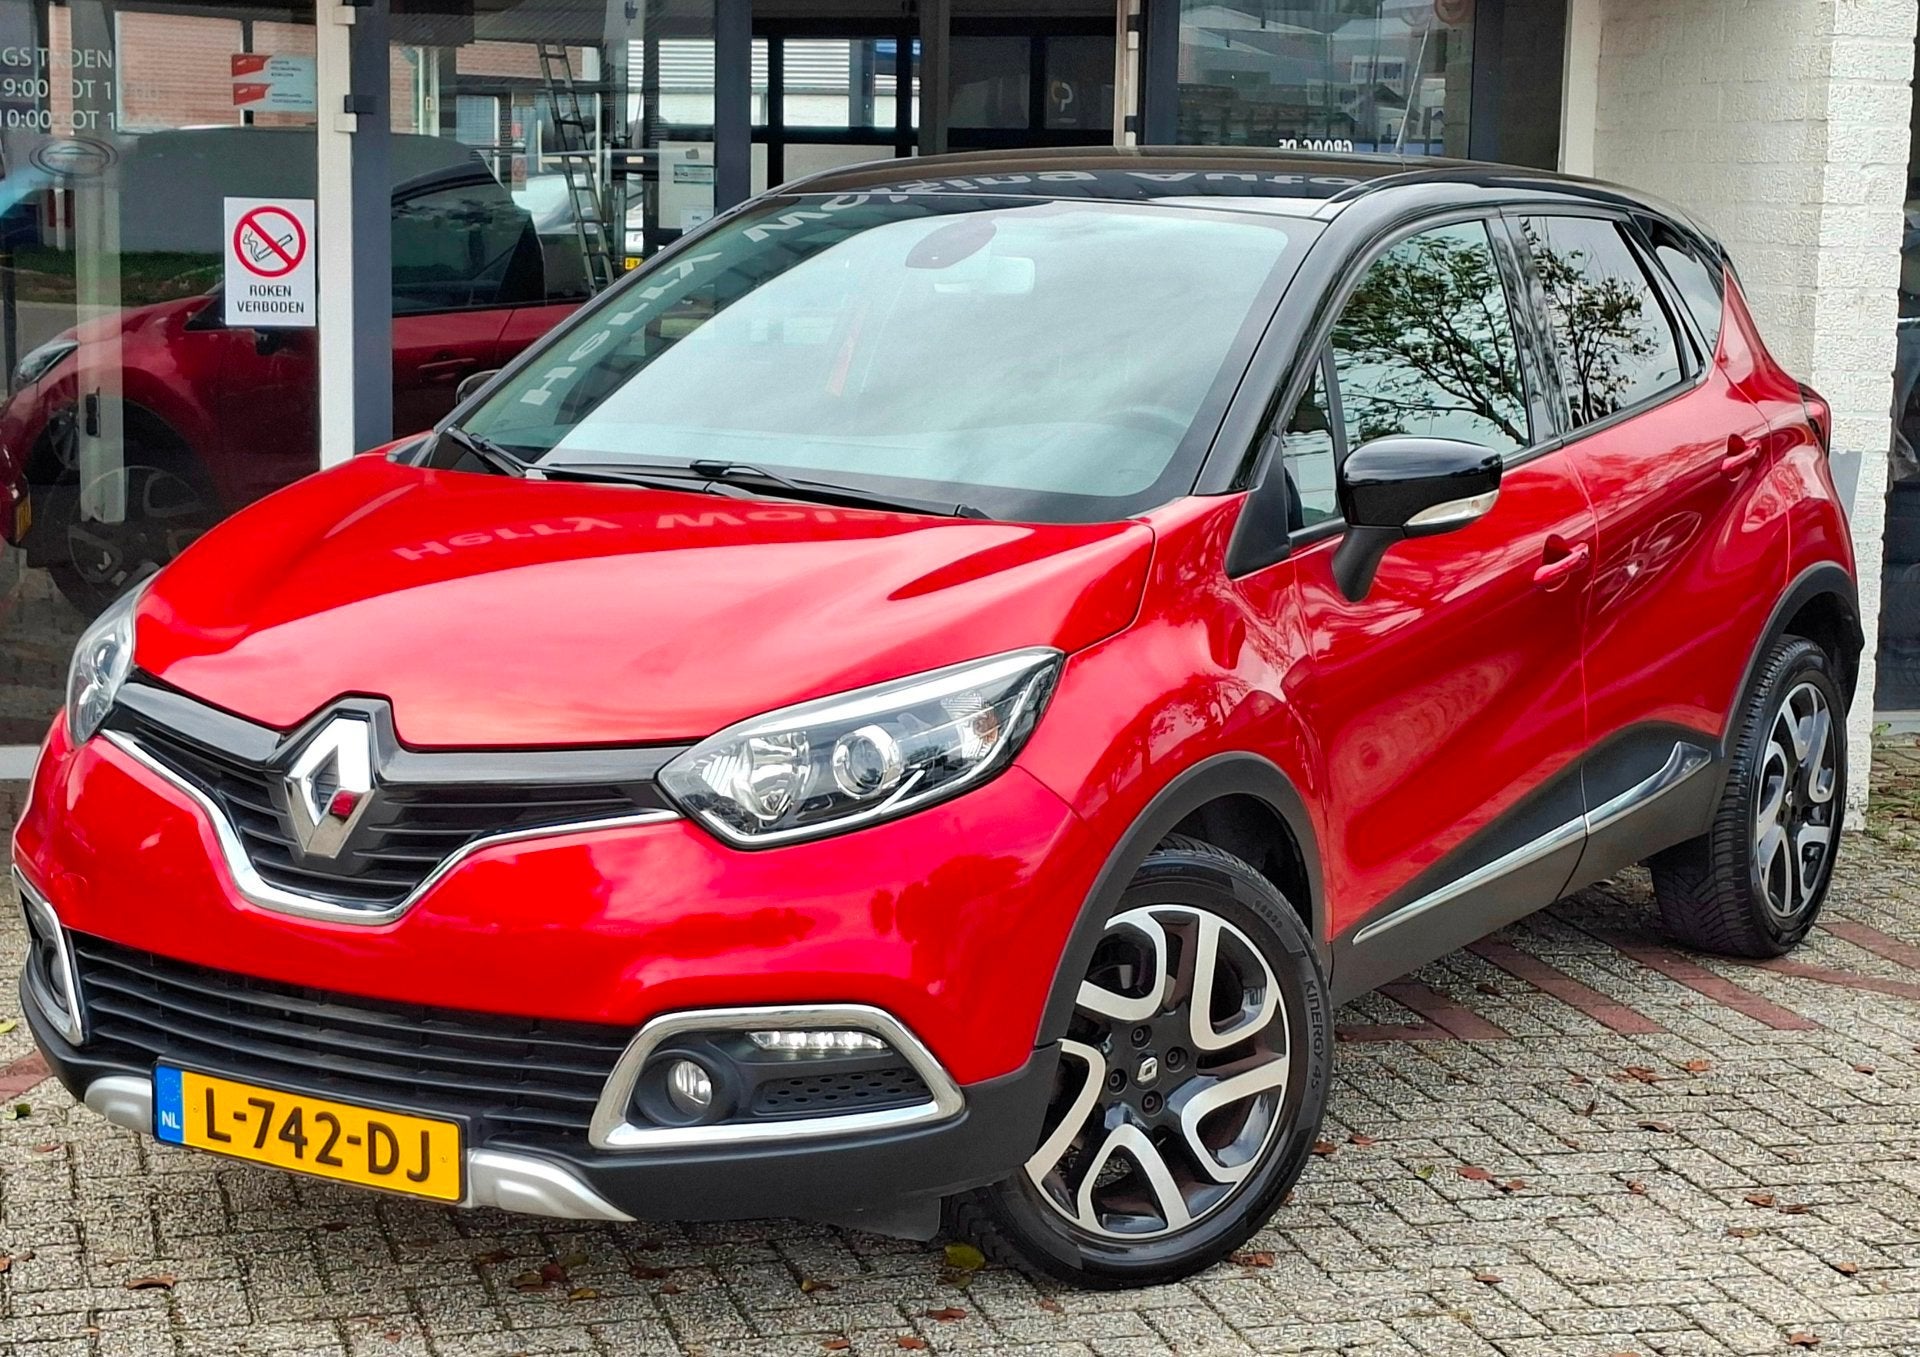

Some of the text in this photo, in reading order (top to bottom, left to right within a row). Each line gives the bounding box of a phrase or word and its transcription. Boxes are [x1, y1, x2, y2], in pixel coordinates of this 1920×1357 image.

[249, 284, 292, 297] ROKEN
[237, 300, 304, 314] VERBODEN
[1303, 979, 1324, 1062] KINERGY
[161, 1110, 180, 1129] NL
[205, 1086, 430, 1182] L-742-DJ
